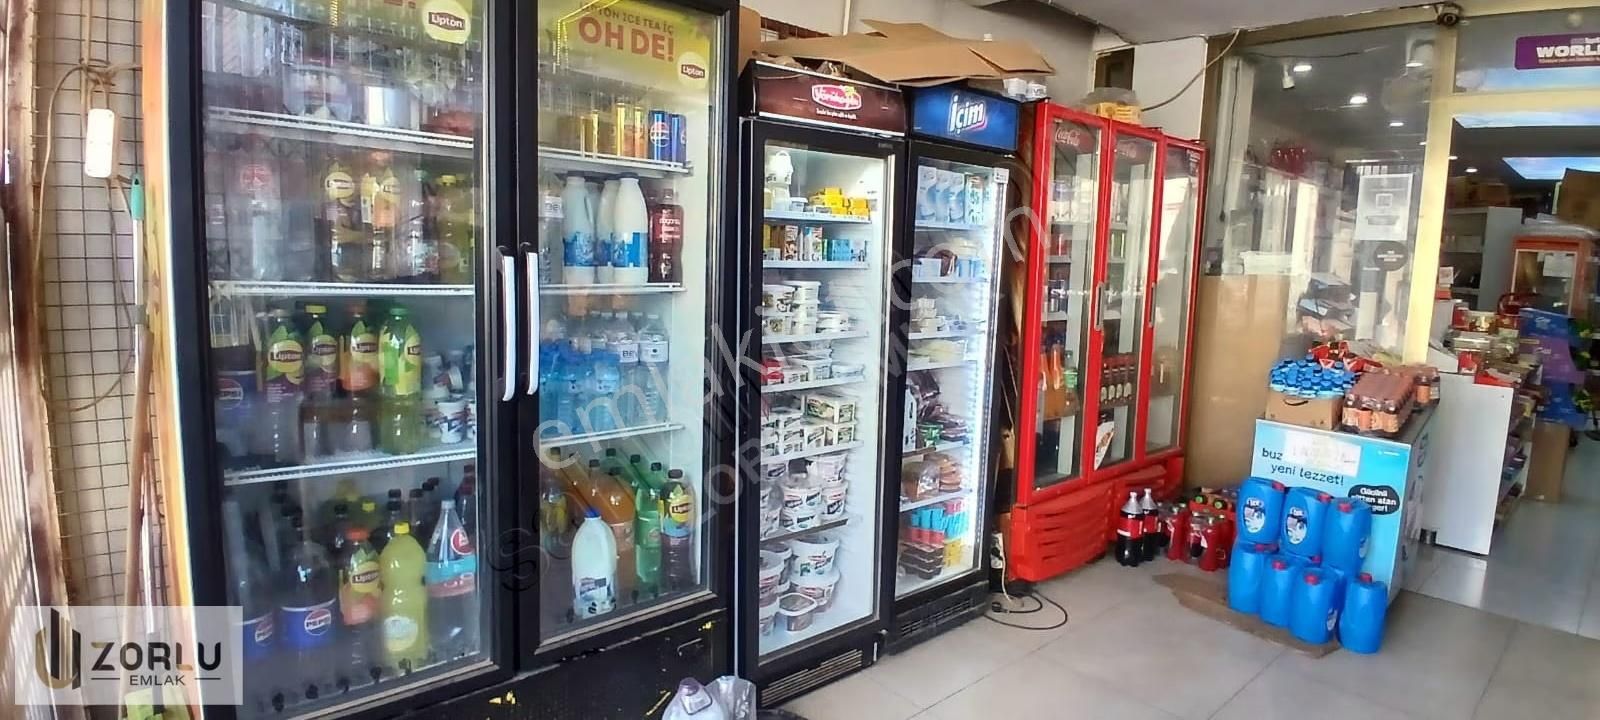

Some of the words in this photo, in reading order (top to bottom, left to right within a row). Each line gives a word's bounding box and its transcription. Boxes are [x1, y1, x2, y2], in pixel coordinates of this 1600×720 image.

[431, 13, 463, 28] Lipton
[578, 17, 624, 50] OH
[631, 28, 675, 62] DE!
[682, 65, 705, 77] Lipton
[949, 94, 984, 135] İçim
[1262, 447, 1283, 460] buz
[1271, 464, 1296, 475] yeni
[1300, 467, 1344, 486] lezzet!
